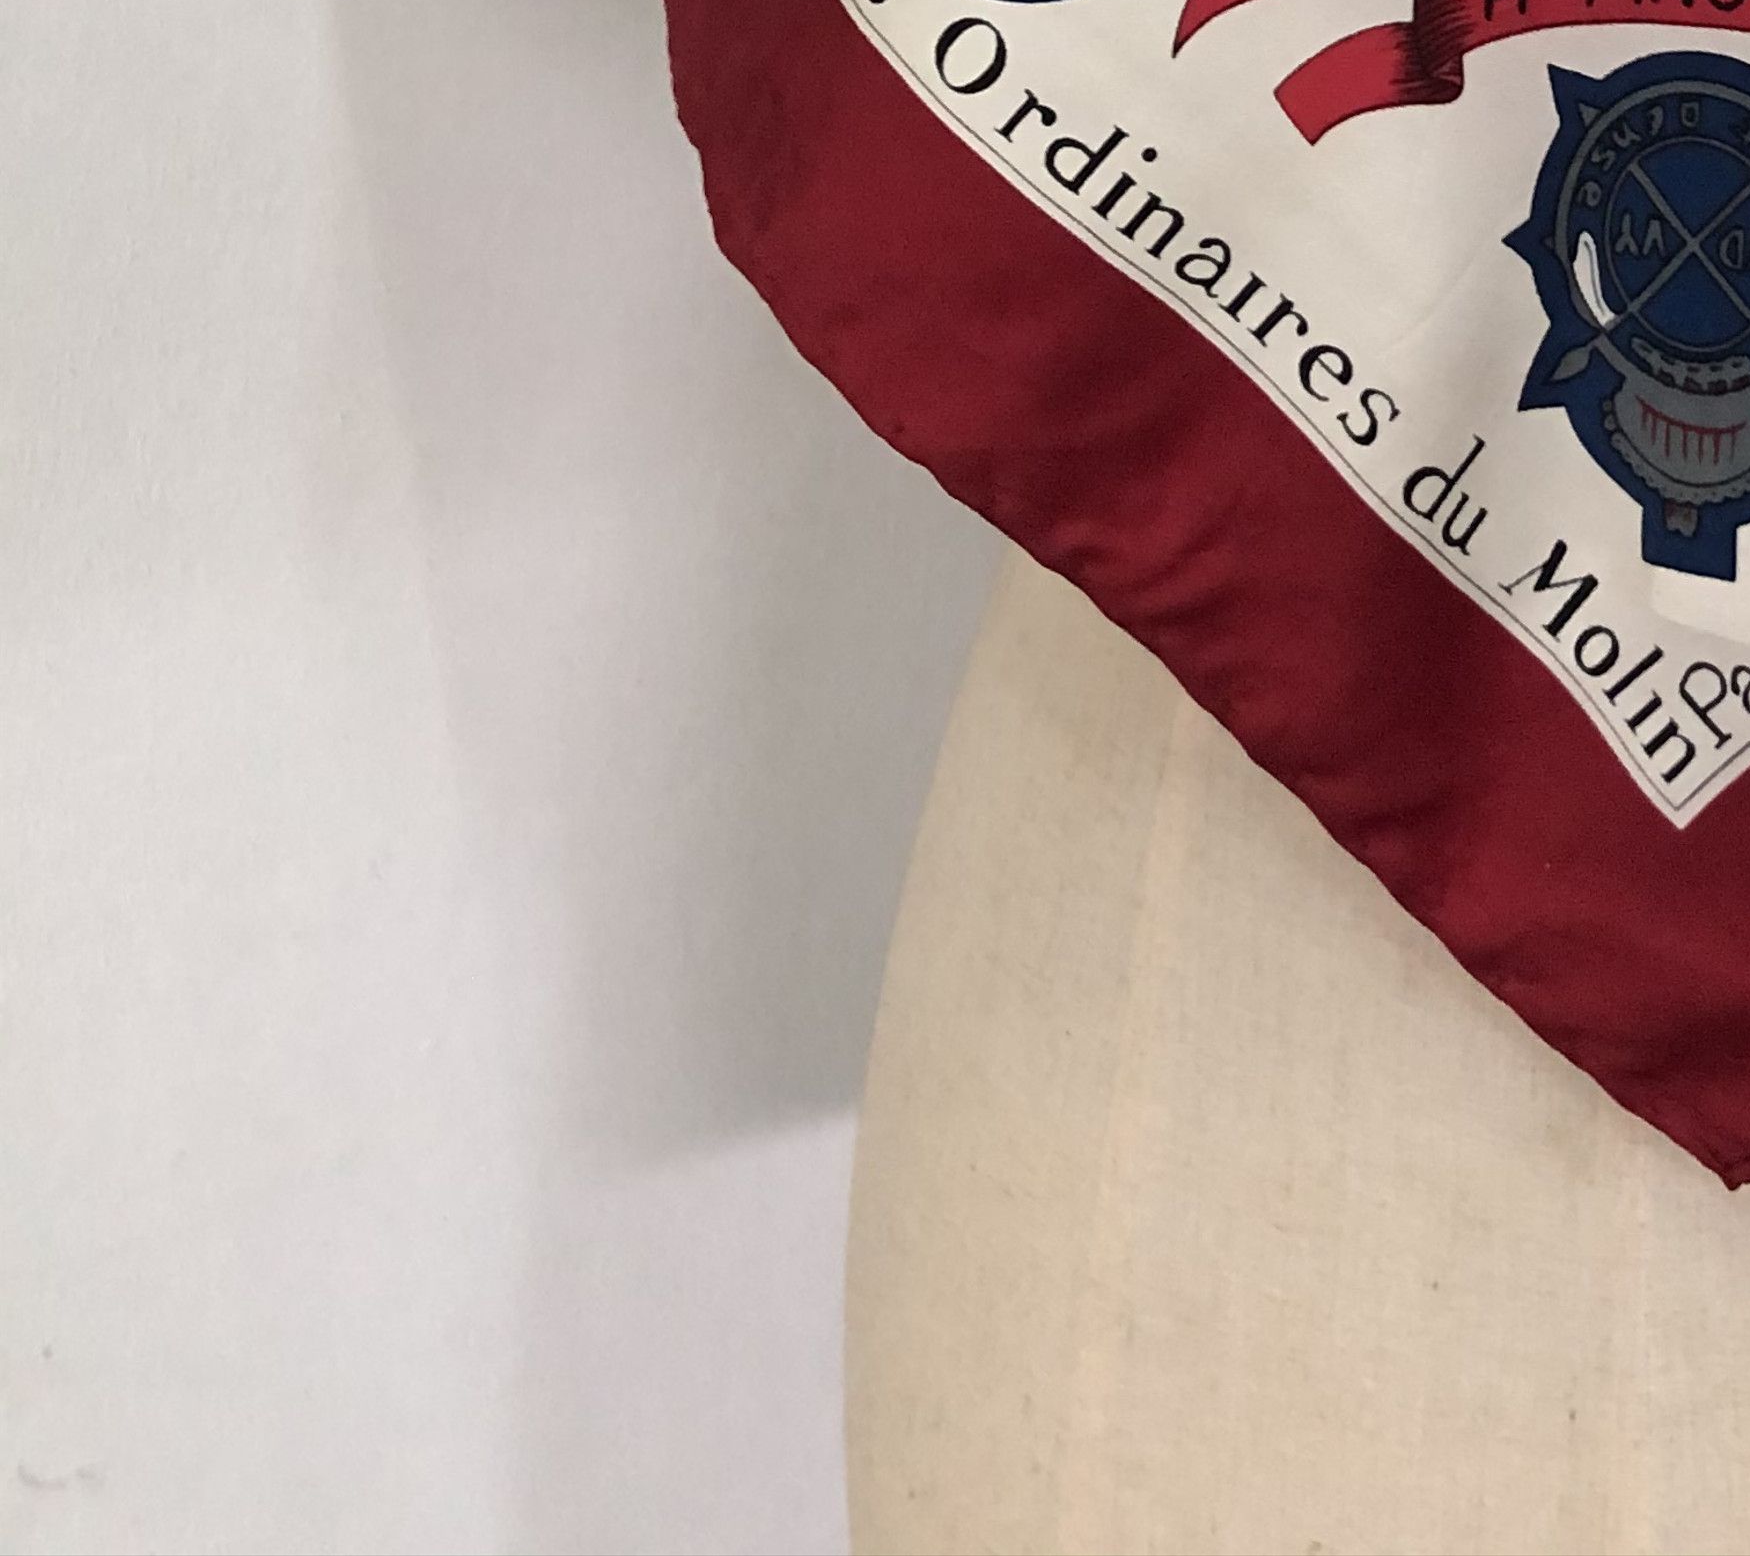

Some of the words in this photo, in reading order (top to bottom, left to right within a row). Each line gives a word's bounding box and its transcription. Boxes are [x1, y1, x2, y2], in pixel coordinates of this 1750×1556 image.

[934, 16, 1402, 447] Ordinaires
[1402, 433, 1489, 557] du
[1498, 539, 1697, 784] Molin
